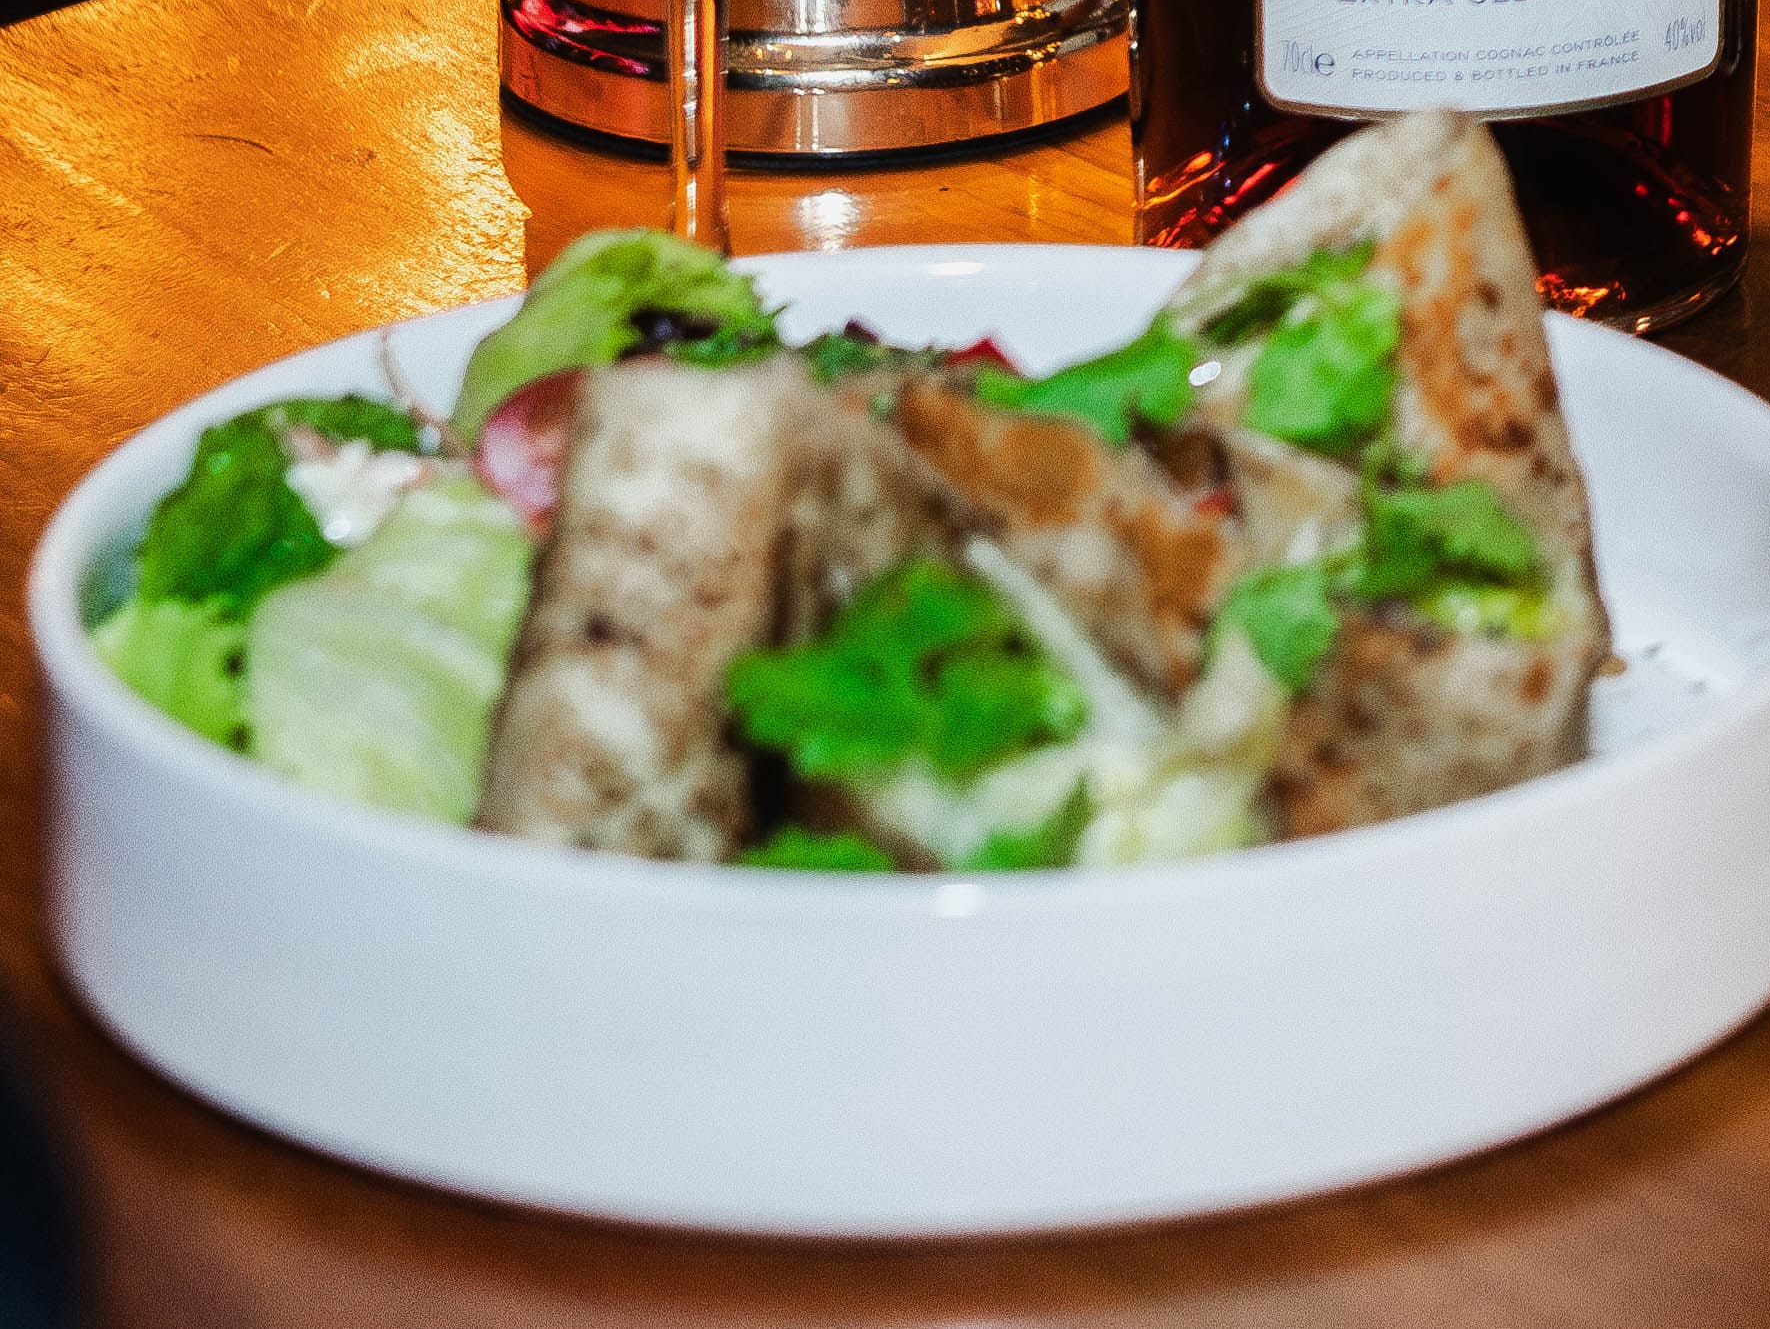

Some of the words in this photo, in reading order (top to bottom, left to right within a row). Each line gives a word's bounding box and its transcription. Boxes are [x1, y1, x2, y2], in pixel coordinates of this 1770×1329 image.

[1351, 49, 1470, 62] APPELLATION
[1475, 45, 1546, 60] COGNAC
[1351, 68, 1448, 82] PRODUCED
[1454, 70, 1464, 81] &
[1471, 65, 1548, 81] BOTTLED
[1555, 62, 1572, 74] IN
[1576, 50, 1641, 71] FRANCE
